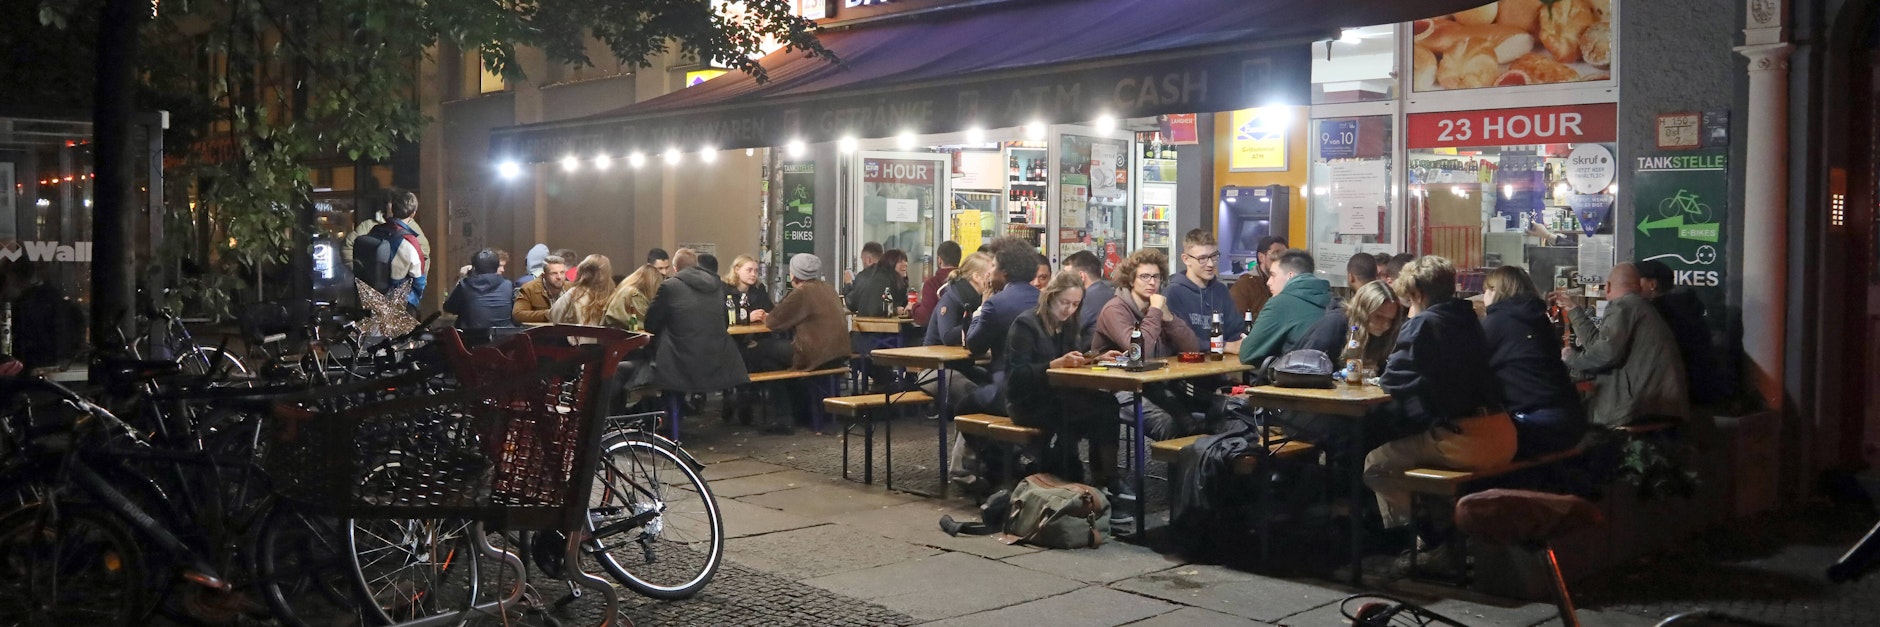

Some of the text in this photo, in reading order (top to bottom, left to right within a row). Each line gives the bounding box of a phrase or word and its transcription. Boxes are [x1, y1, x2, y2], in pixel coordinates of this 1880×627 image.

[1003, 70, 1209, 116] ATM CASH
[1437, 112, 1584, 142] 23 HOUR
[1321, 132, 1330, 145] 9
[1339, 131, 1354, 145] 10
[1572, 154, 1598, 165] skruf
[1637, 155, 1724, 169] TANKSTELLE
[784, 163, 814, 173] TANKSTELLE
[883, 163, 927, 180] HOUR
[784, 230, 814, 241] E-BIKES
[1681, 228, 1716, 237] E-BIKES
[23, 240, 93, 262] Wall
[1673, 270, 1719, 287] IKES
